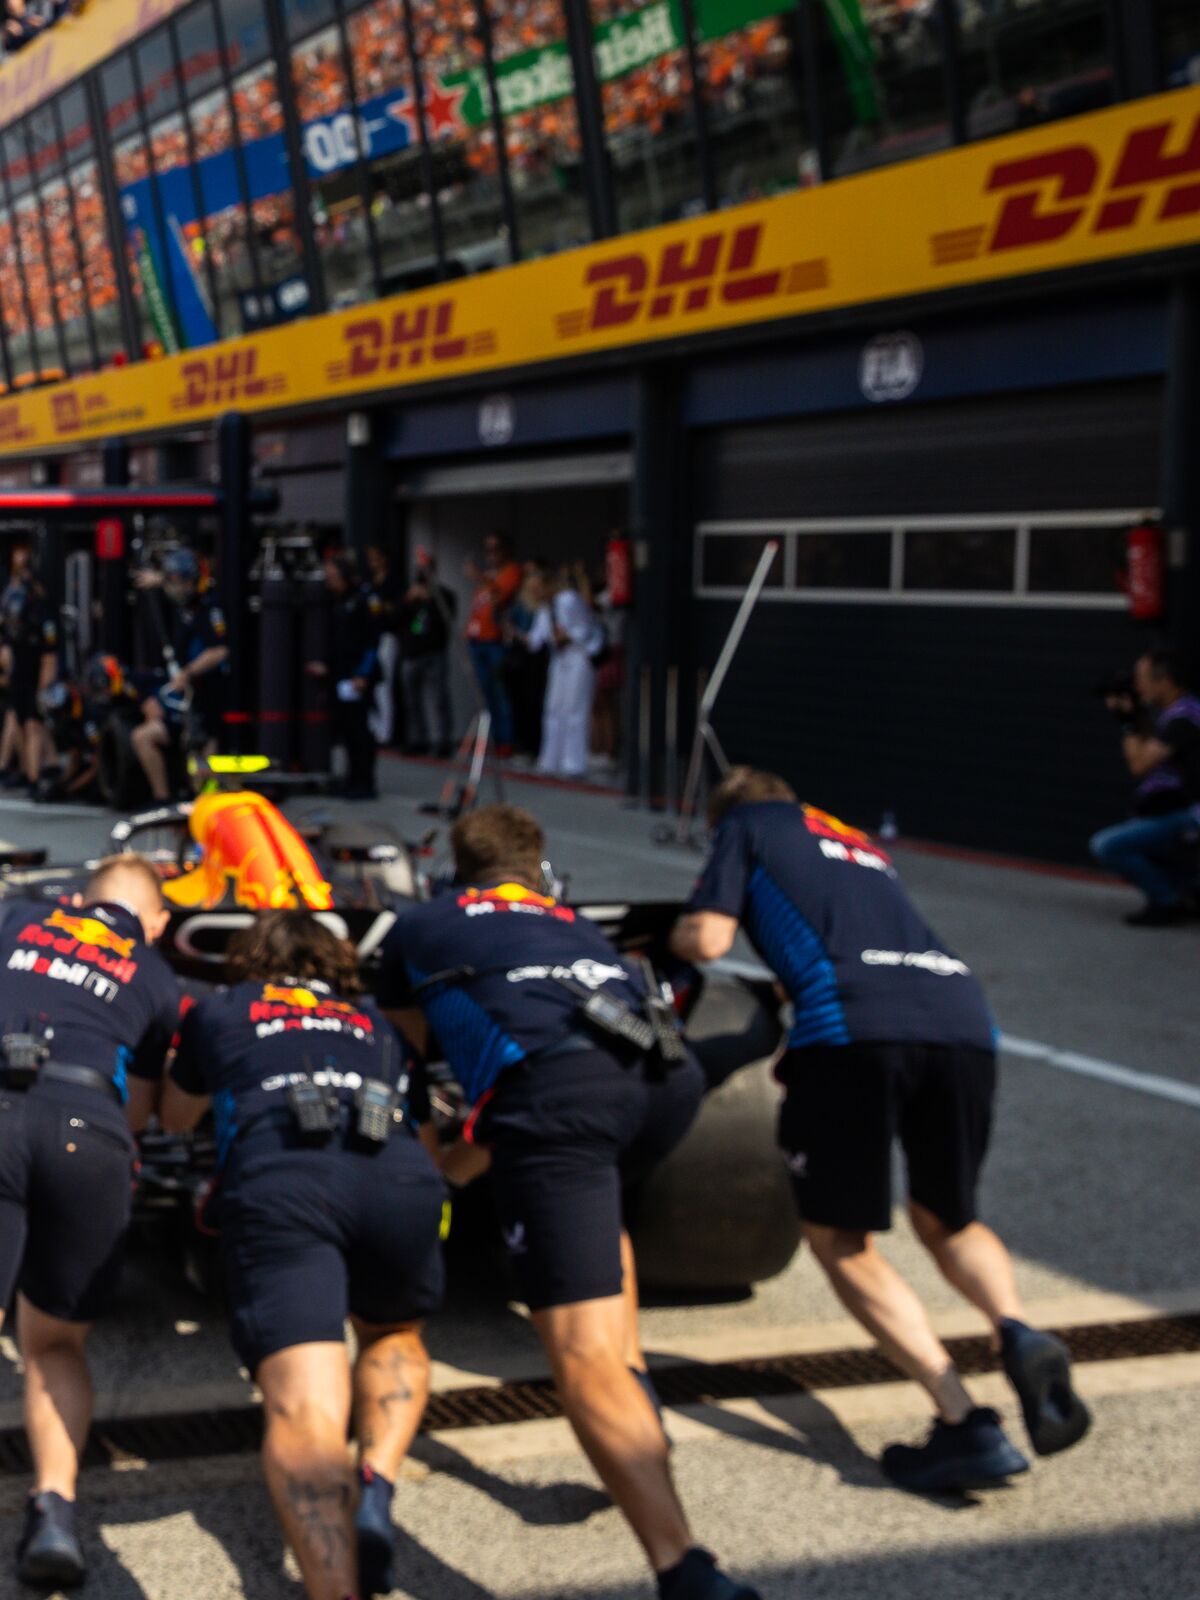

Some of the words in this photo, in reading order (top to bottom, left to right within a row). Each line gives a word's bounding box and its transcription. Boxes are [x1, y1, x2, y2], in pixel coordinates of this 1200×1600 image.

[584, 221, 781, 331] DHL
[344, 299, 468, 377] DHL
[181, 347, 268, 407] DHL
[7, 948, 90, 986] Mobil
